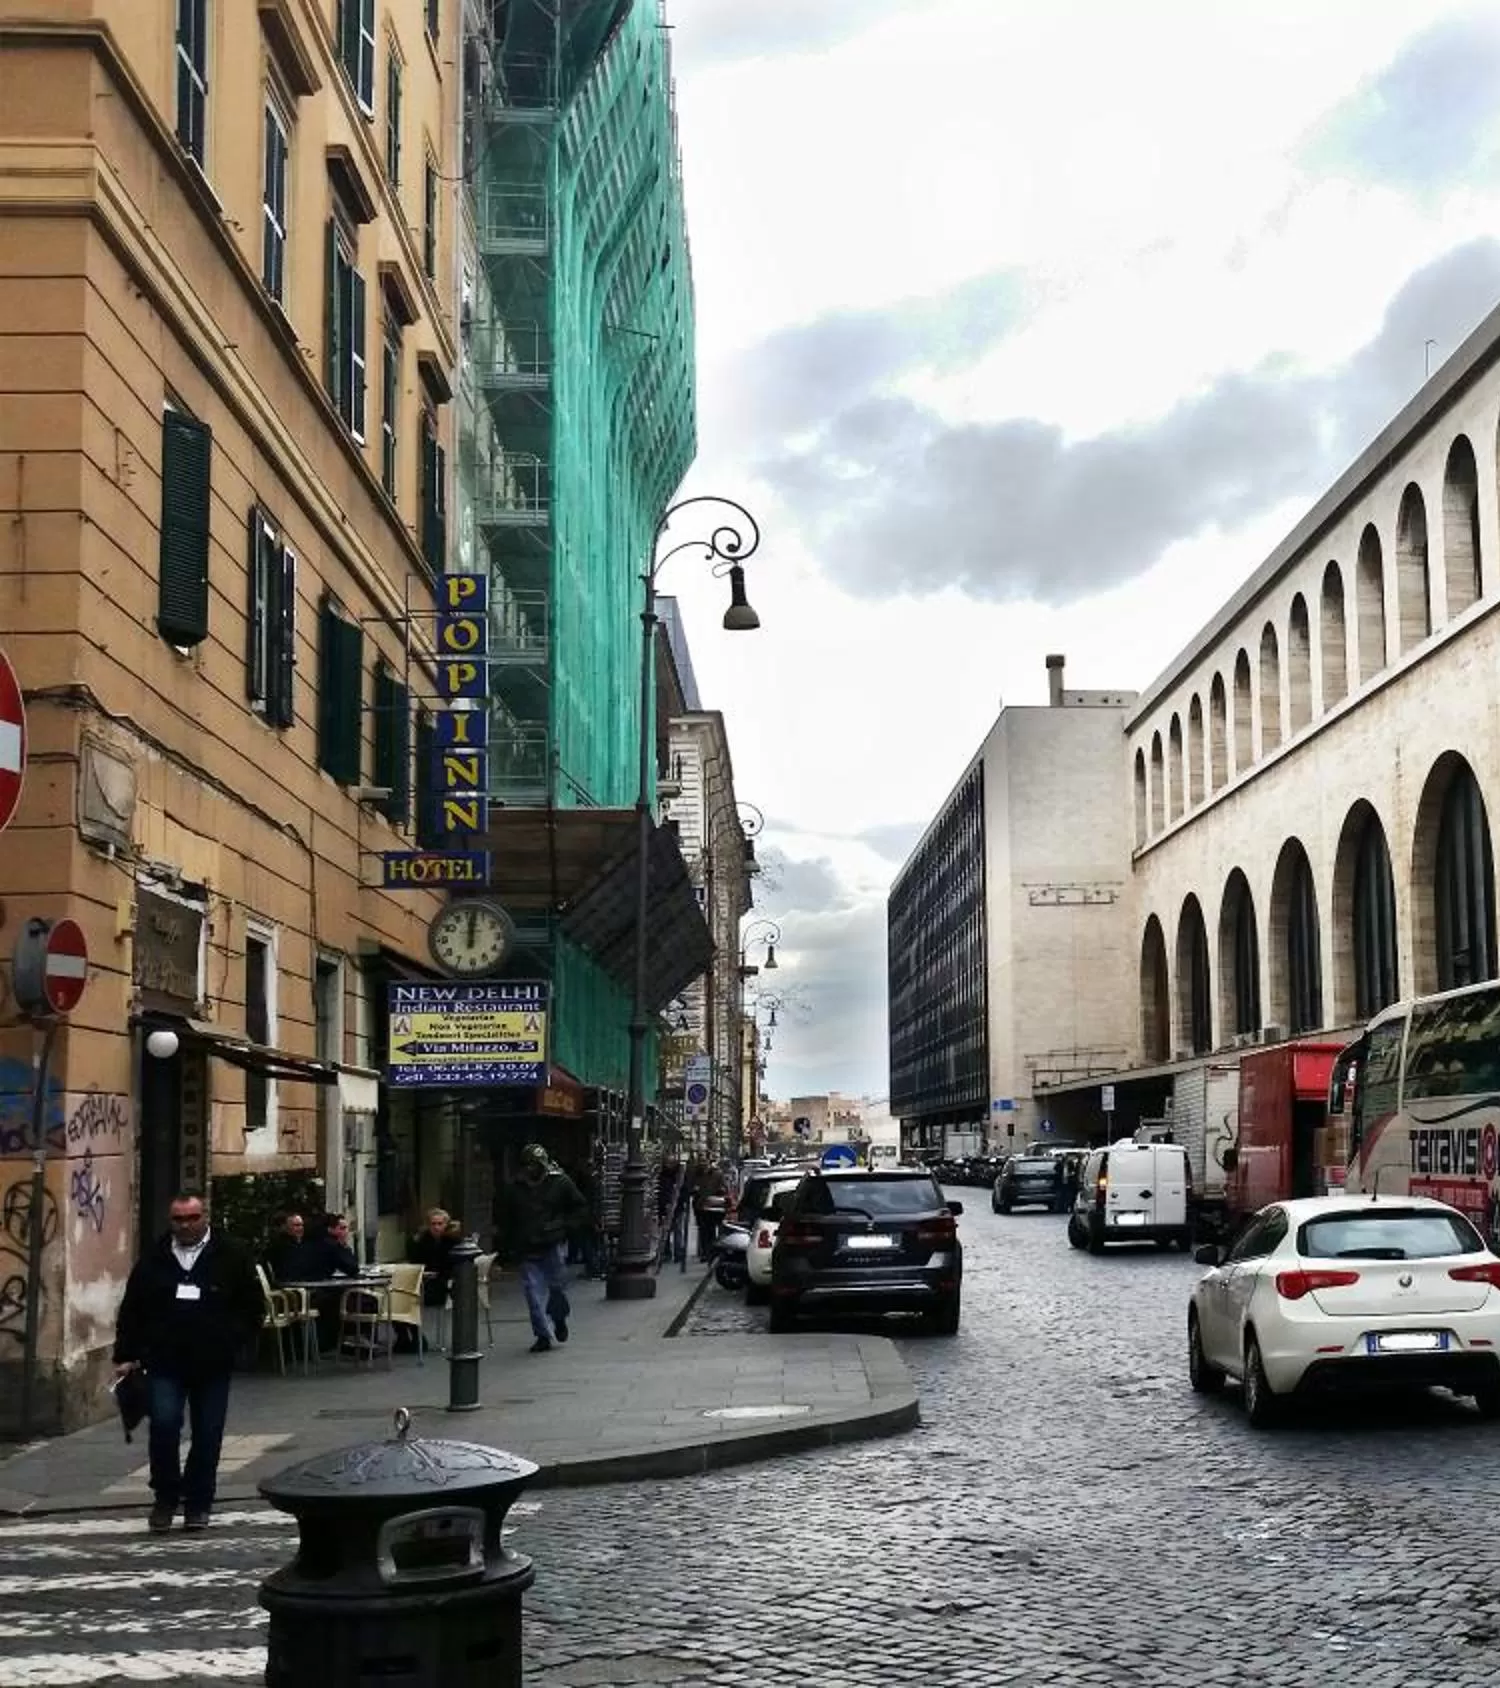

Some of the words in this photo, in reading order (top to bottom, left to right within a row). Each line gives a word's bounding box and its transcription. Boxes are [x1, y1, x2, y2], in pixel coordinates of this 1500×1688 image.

[387, 858, 482, 881] HOTEL
[396, 987, 457, 1000] NEW
[468, 985, 540, 1000] DELHI
[395, 1002, 447, 1013] Indian
[453, 1001, 540, 1013] Restaurant
[423, 1043, 447, 1053] Via
